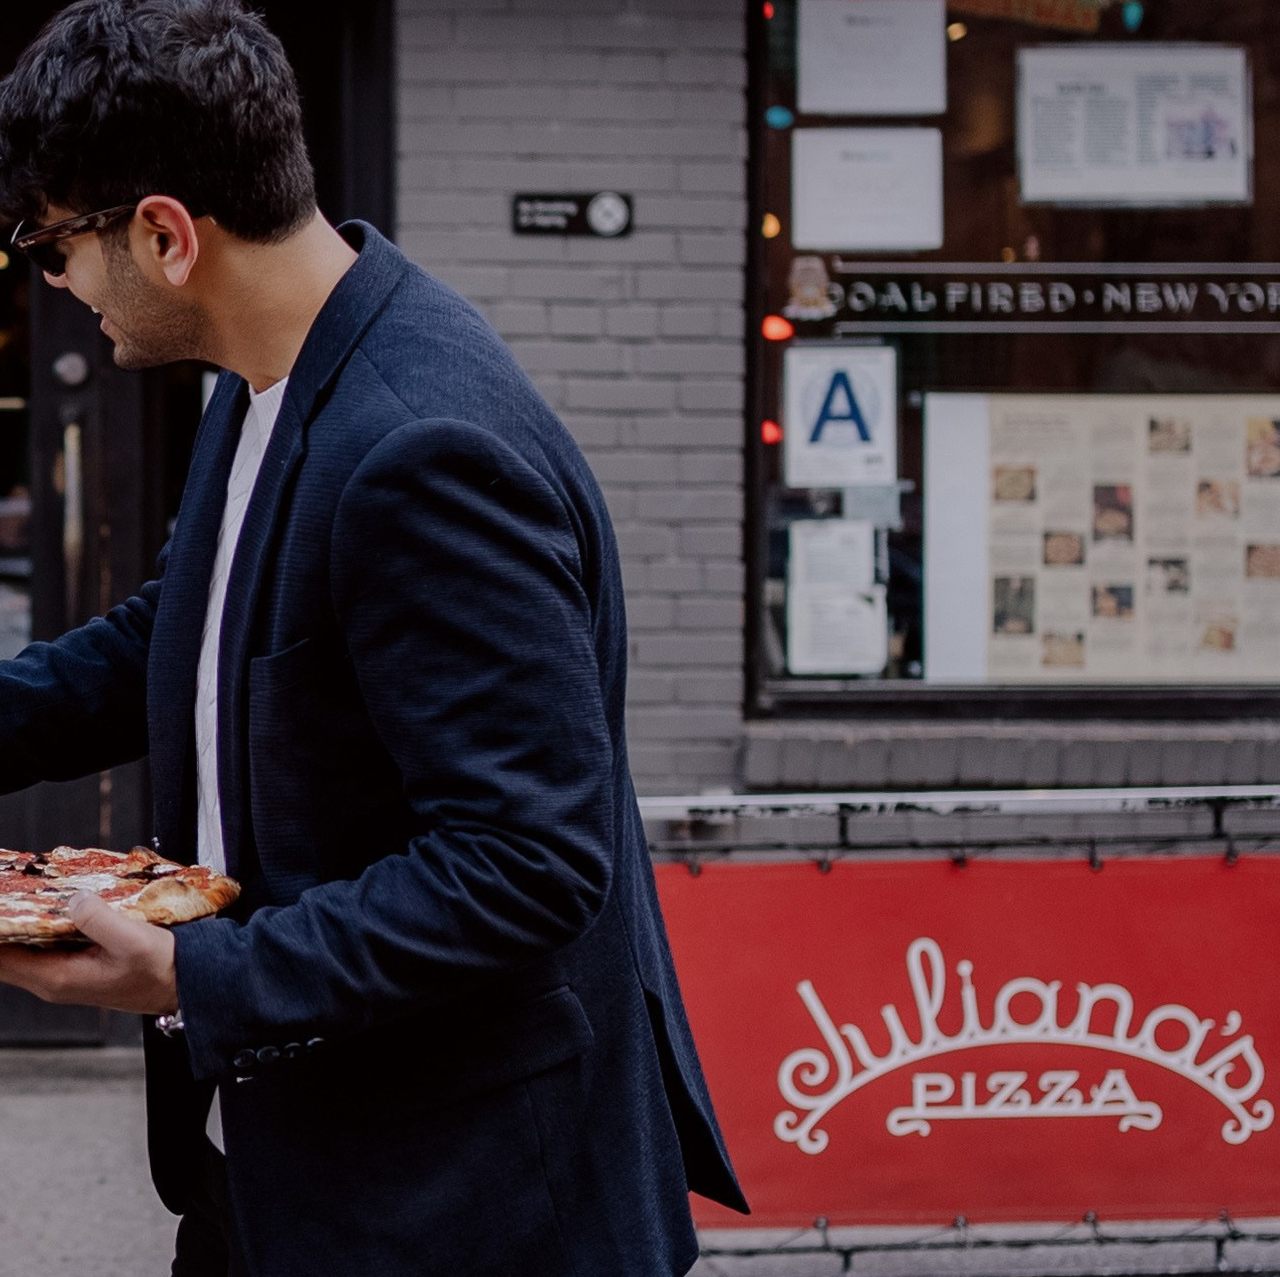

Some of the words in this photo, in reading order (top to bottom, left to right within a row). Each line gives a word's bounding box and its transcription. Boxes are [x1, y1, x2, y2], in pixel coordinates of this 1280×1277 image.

[808, 370, 872, 444] A
[777, 936, 1266, 1114] Juliana's
[912, 1067, 1147, 1116] PIZZA
